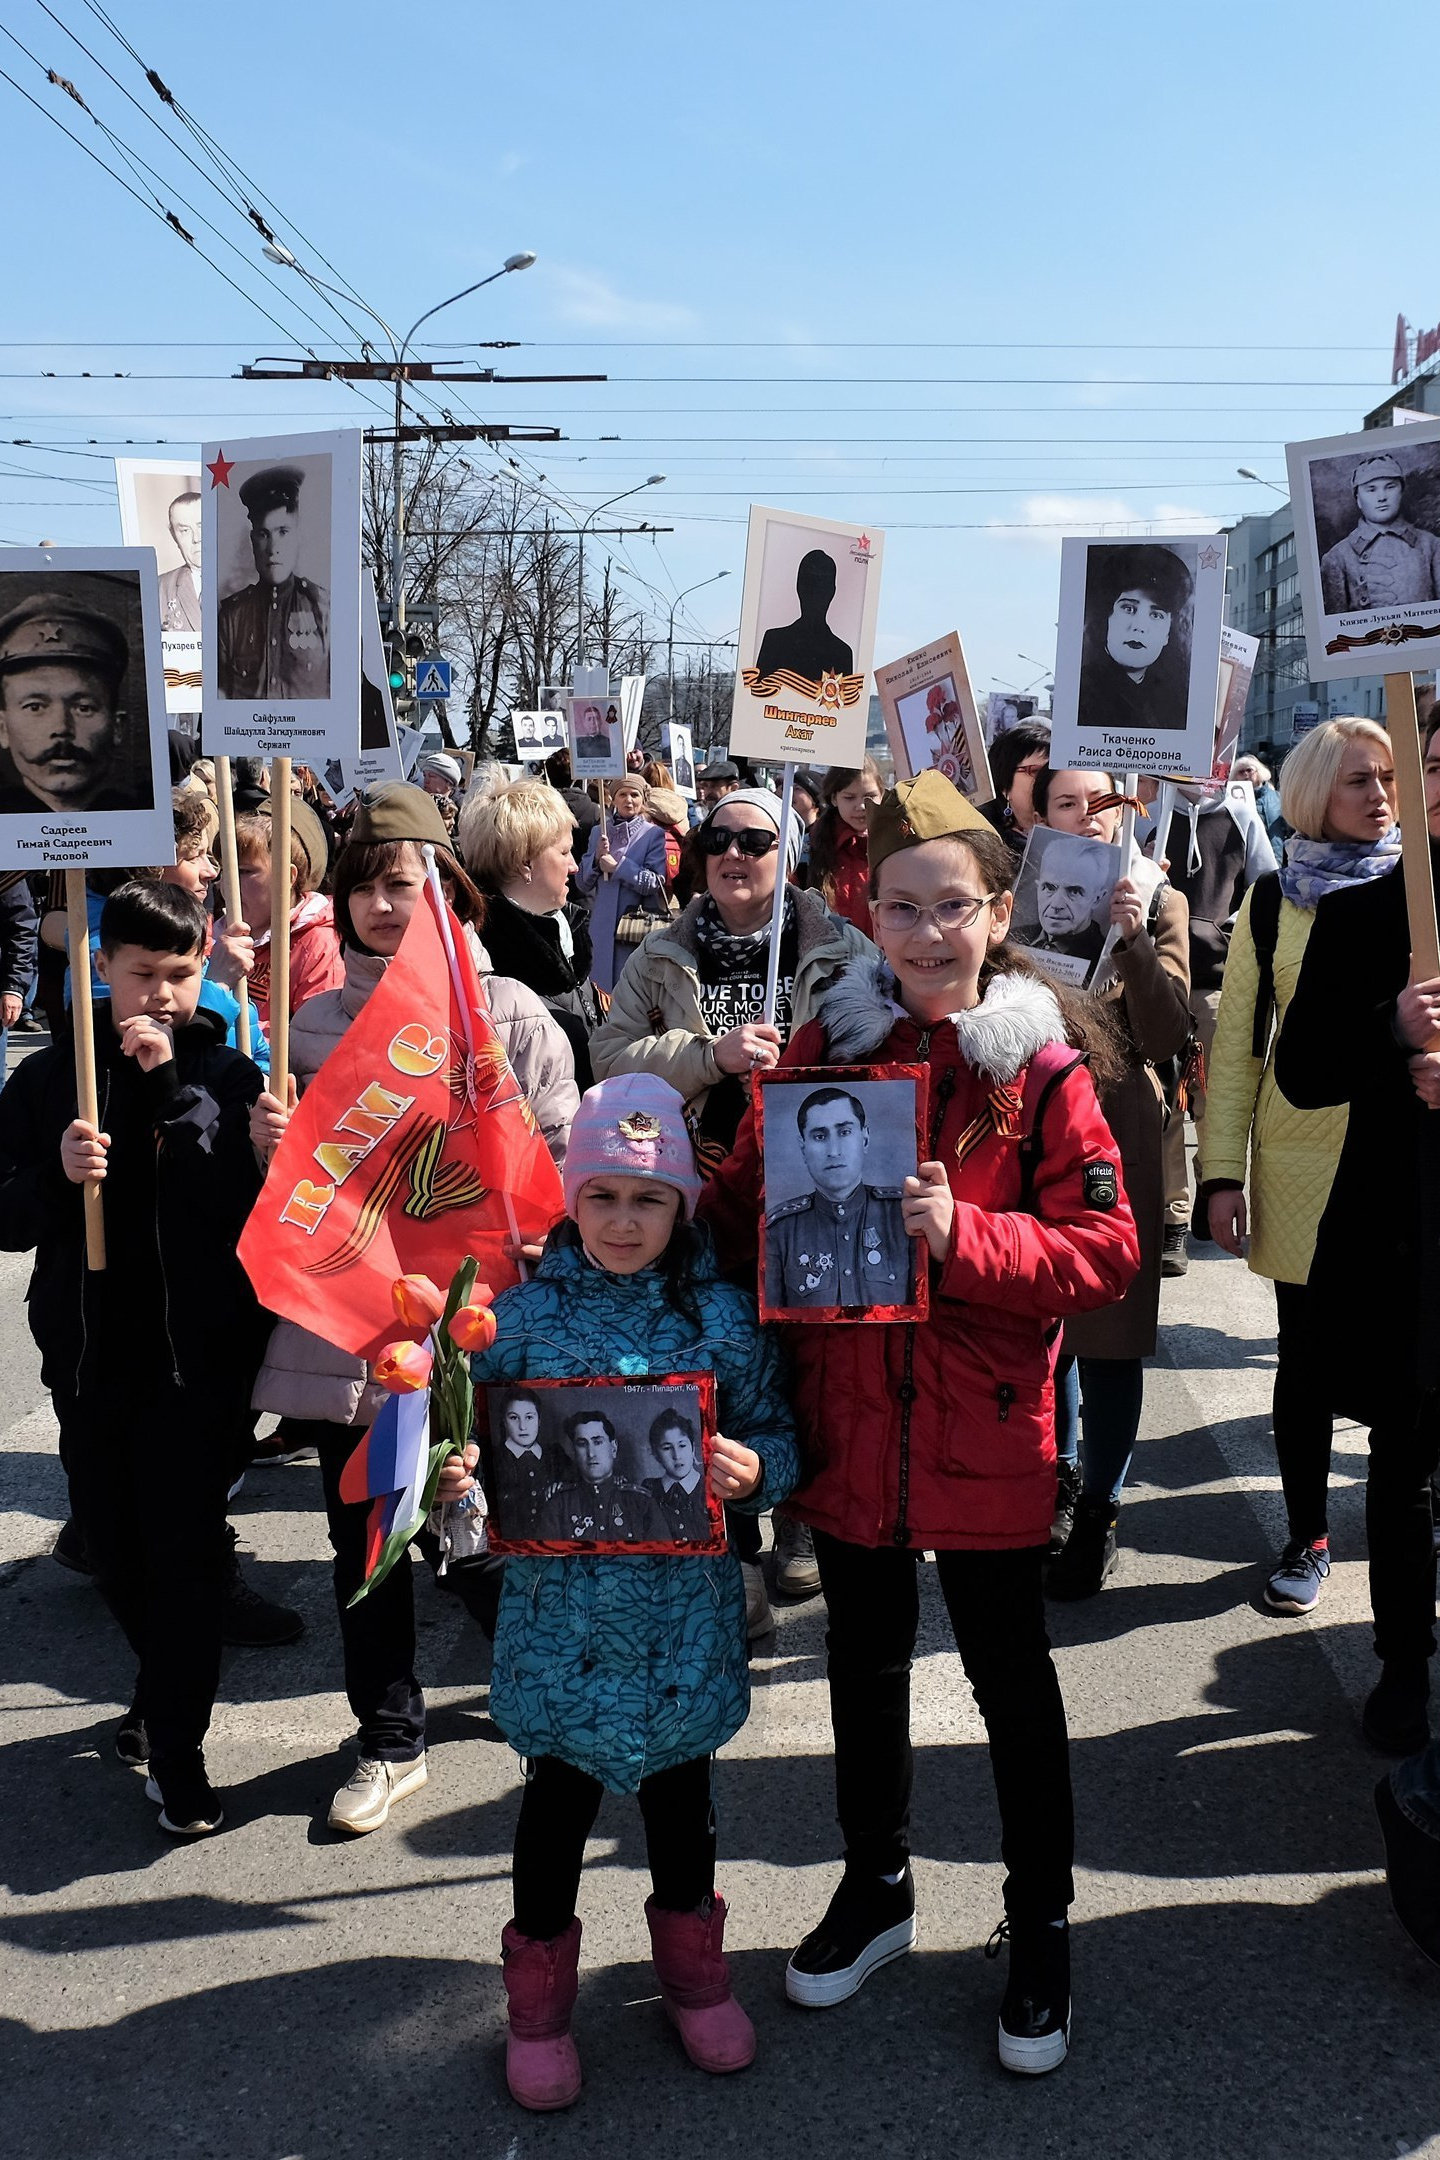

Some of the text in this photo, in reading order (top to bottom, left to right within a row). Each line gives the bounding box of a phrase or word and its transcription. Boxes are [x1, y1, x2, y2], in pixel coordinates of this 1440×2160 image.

[1339, 618, 1369, 627] Князев
[1370, 613, 1401, 624] Лукьян
[161, 641, 195, 652] Пухарев
[763, 704, 838, 728] Шингаряев
[785, 724, 815, 741] Ахат
[257, 740, 291, 750] Сержант
[1102, 733, 1156, 746] Ткаченко
[1078, 745, 1182, 761] Раиса Фёдоровна
[1067, 760, 1191, 773] рядовой медицинской службы
[40, 825, 88, 837] Садреев
[16, 838, 113, 850] Гимай Садреевич
[42, 852, 89, 862] Рядовой
[737, 983, 765, 1000] TO
